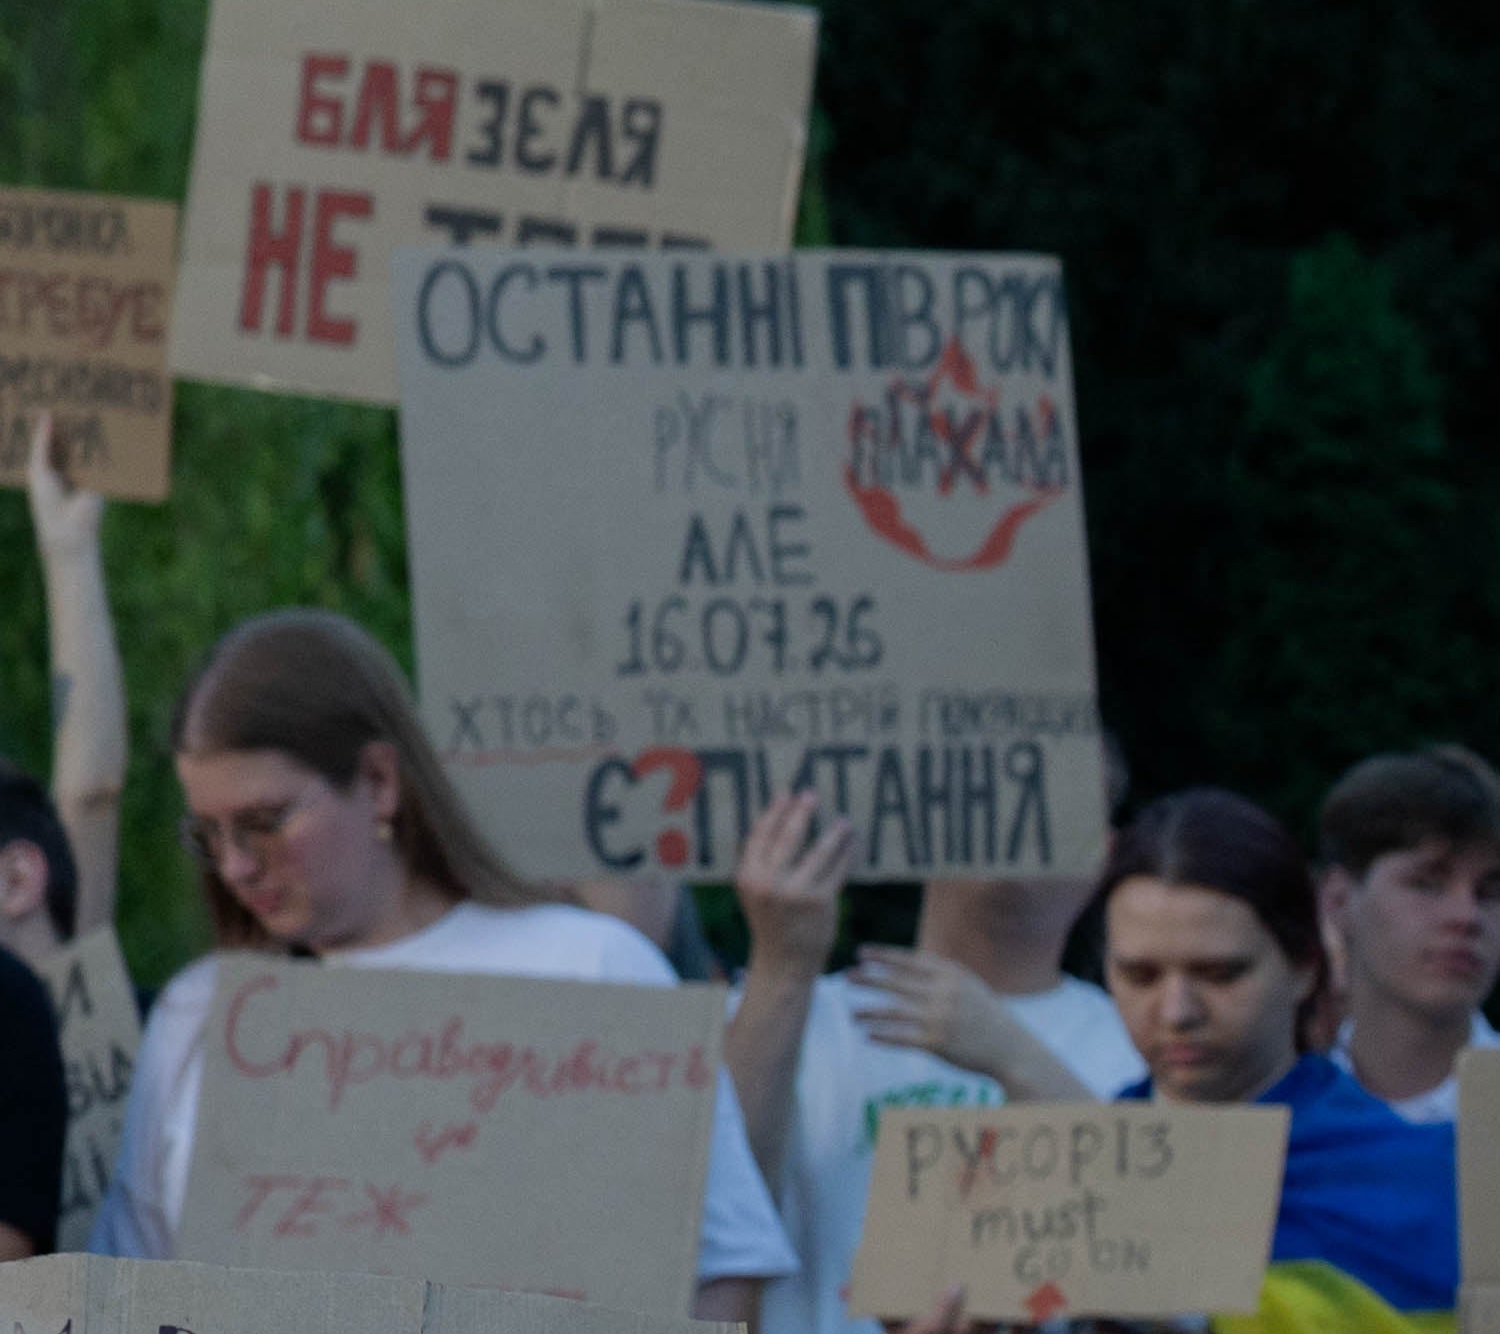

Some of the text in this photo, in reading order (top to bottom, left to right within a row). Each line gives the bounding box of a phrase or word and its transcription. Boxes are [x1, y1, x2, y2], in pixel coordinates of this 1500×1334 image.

[240, 179, 374, 347] НЕ
[416, 257, 803, 370] ОСТАННІ
[677, 505, 816, 589] АЛЕ
[232, 1171, 432, 1239] ТЕЖ
[971, 1189, 1107, 1247] must
